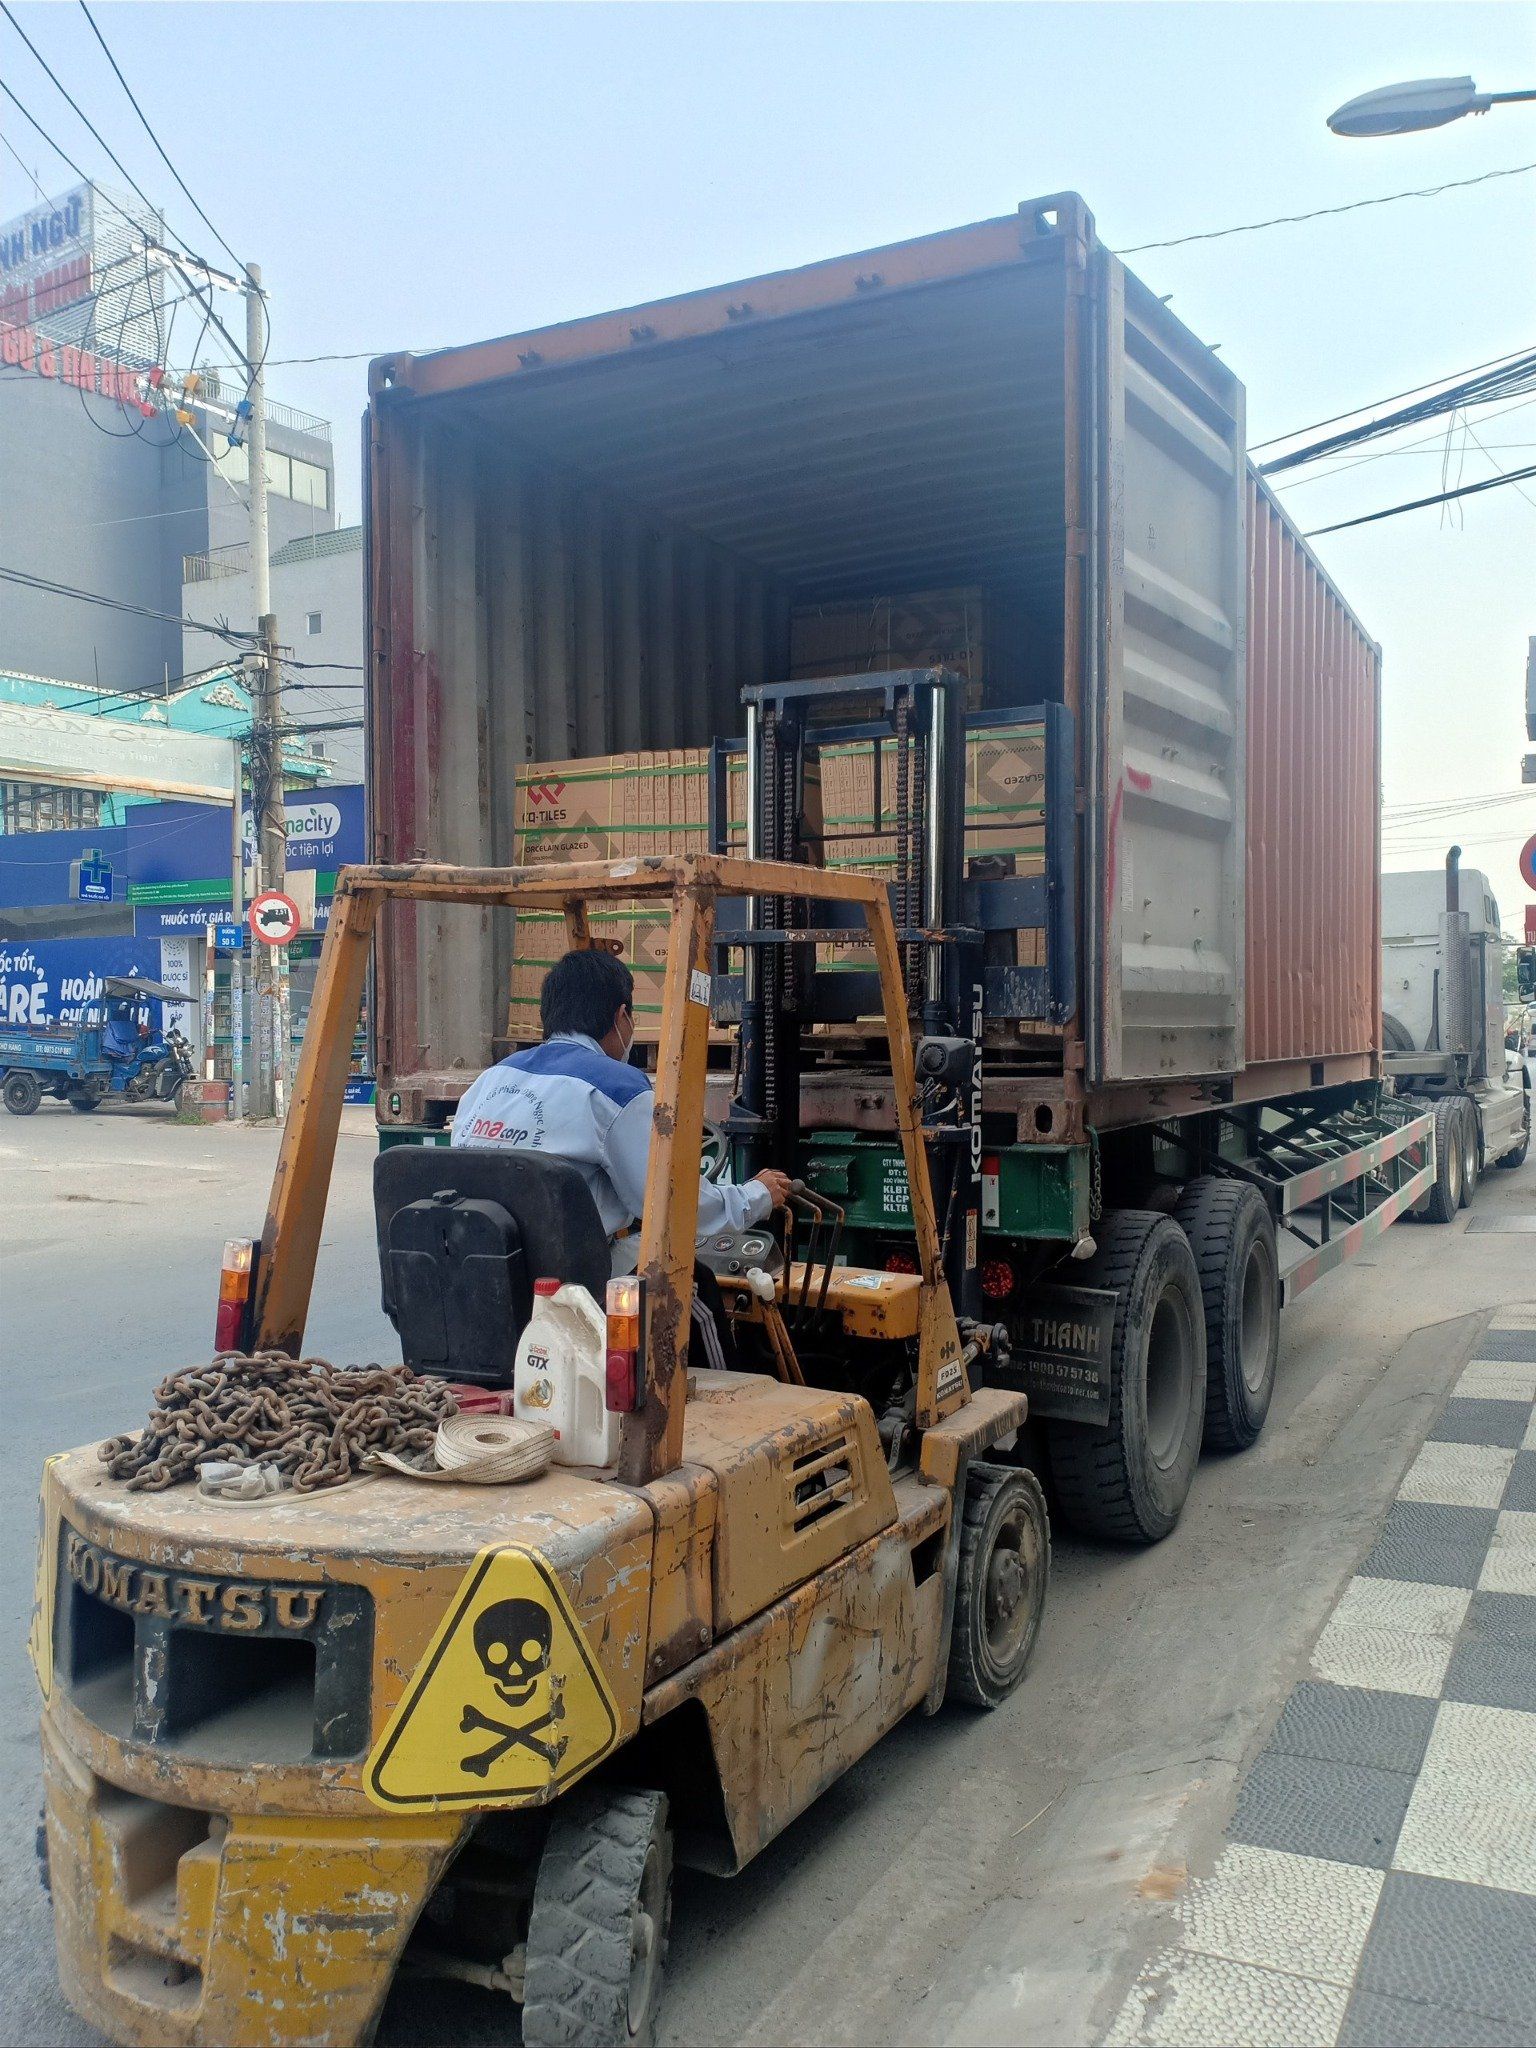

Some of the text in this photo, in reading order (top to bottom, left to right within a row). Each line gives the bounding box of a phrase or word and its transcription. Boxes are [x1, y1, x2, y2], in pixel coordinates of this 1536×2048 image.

[1004, 773, 1044, 785] GLAZED
[300, 842, 319, 858] tiện
[322, 841, 334, 857] lợi
[525, 842, 589, 853] ORCELAIN GLAZED
[160, 907, 189, 926] THUỐC
[209, 908, 224, 925] GIÁ
[231, 938, 236, 946] 5
[14, 948, 36, 973] TỐT,
[166, 960, 183, 968] 100%
[531, 1128, 547, 1148] Anh
[883, 1186, 908, 1194] KLBT
[883, 1194, 910, 1203] KLCP
[883, 1203, 908, 1212] KLTB
[1032, 1318, 1100, 1353] THANH
[527, 1354, 550, 1371] GTX
[65, 1530, 327, 1631] KOMATSU
